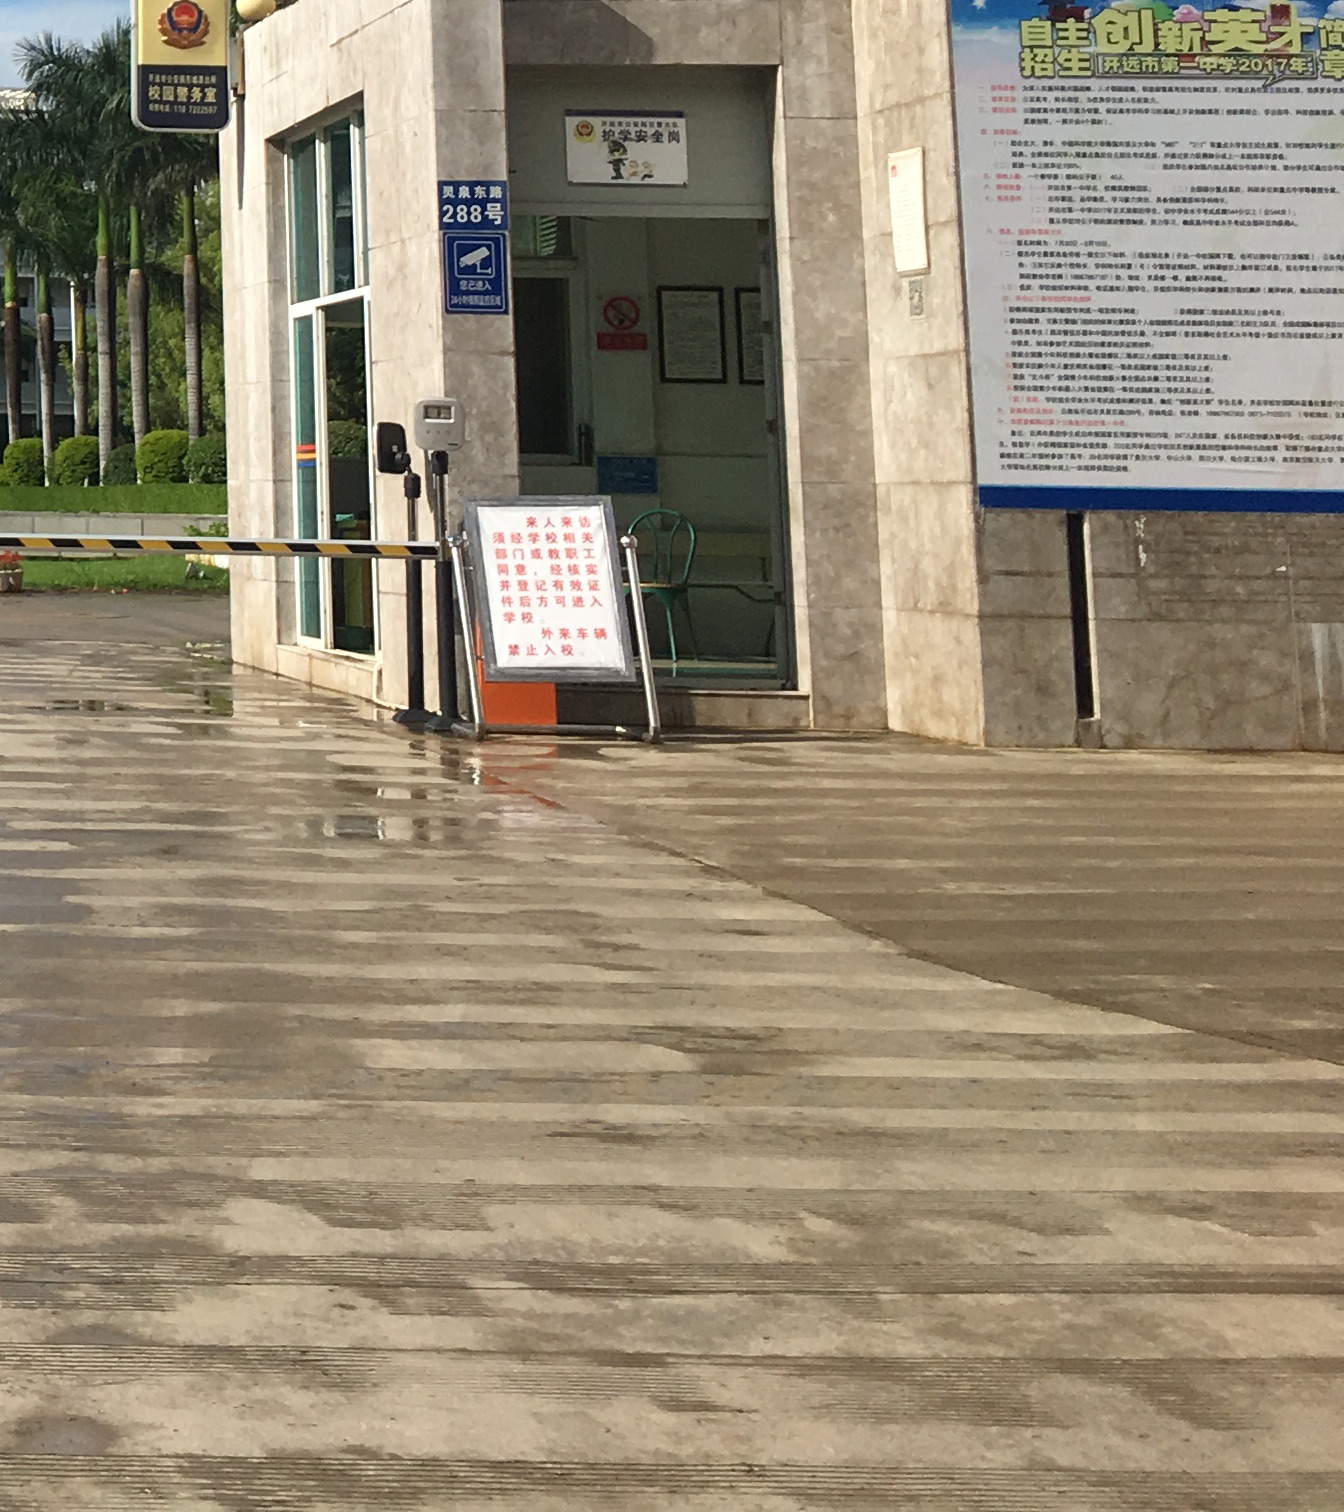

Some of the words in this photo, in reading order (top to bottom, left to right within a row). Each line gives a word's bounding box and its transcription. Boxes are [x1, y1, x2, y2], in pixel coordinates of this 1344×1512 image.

[1019, 16, 1092, 47] 自主
[1091, 7, 1315, 54] 创新英才
[1019, 47, 1093, 78] 招生
[148, 85, 217, 103] 校园警务室
[601, 128, 681, 144] 护学安全岗
[442, 185, 503, 199] 灵泉东路
[442, 202, 505, 225] 288号
[526, 516, 592, 528] 来人来访
[492, 531, 595, 545] 须经学校相关
[494, 548, 597, 561] 部门或教职工
[499, 579, 601, 592] 并登记有效证
[501, 595, 604, 608] 件后方可进入
[541, 627, 609, 640] 外来车辆
